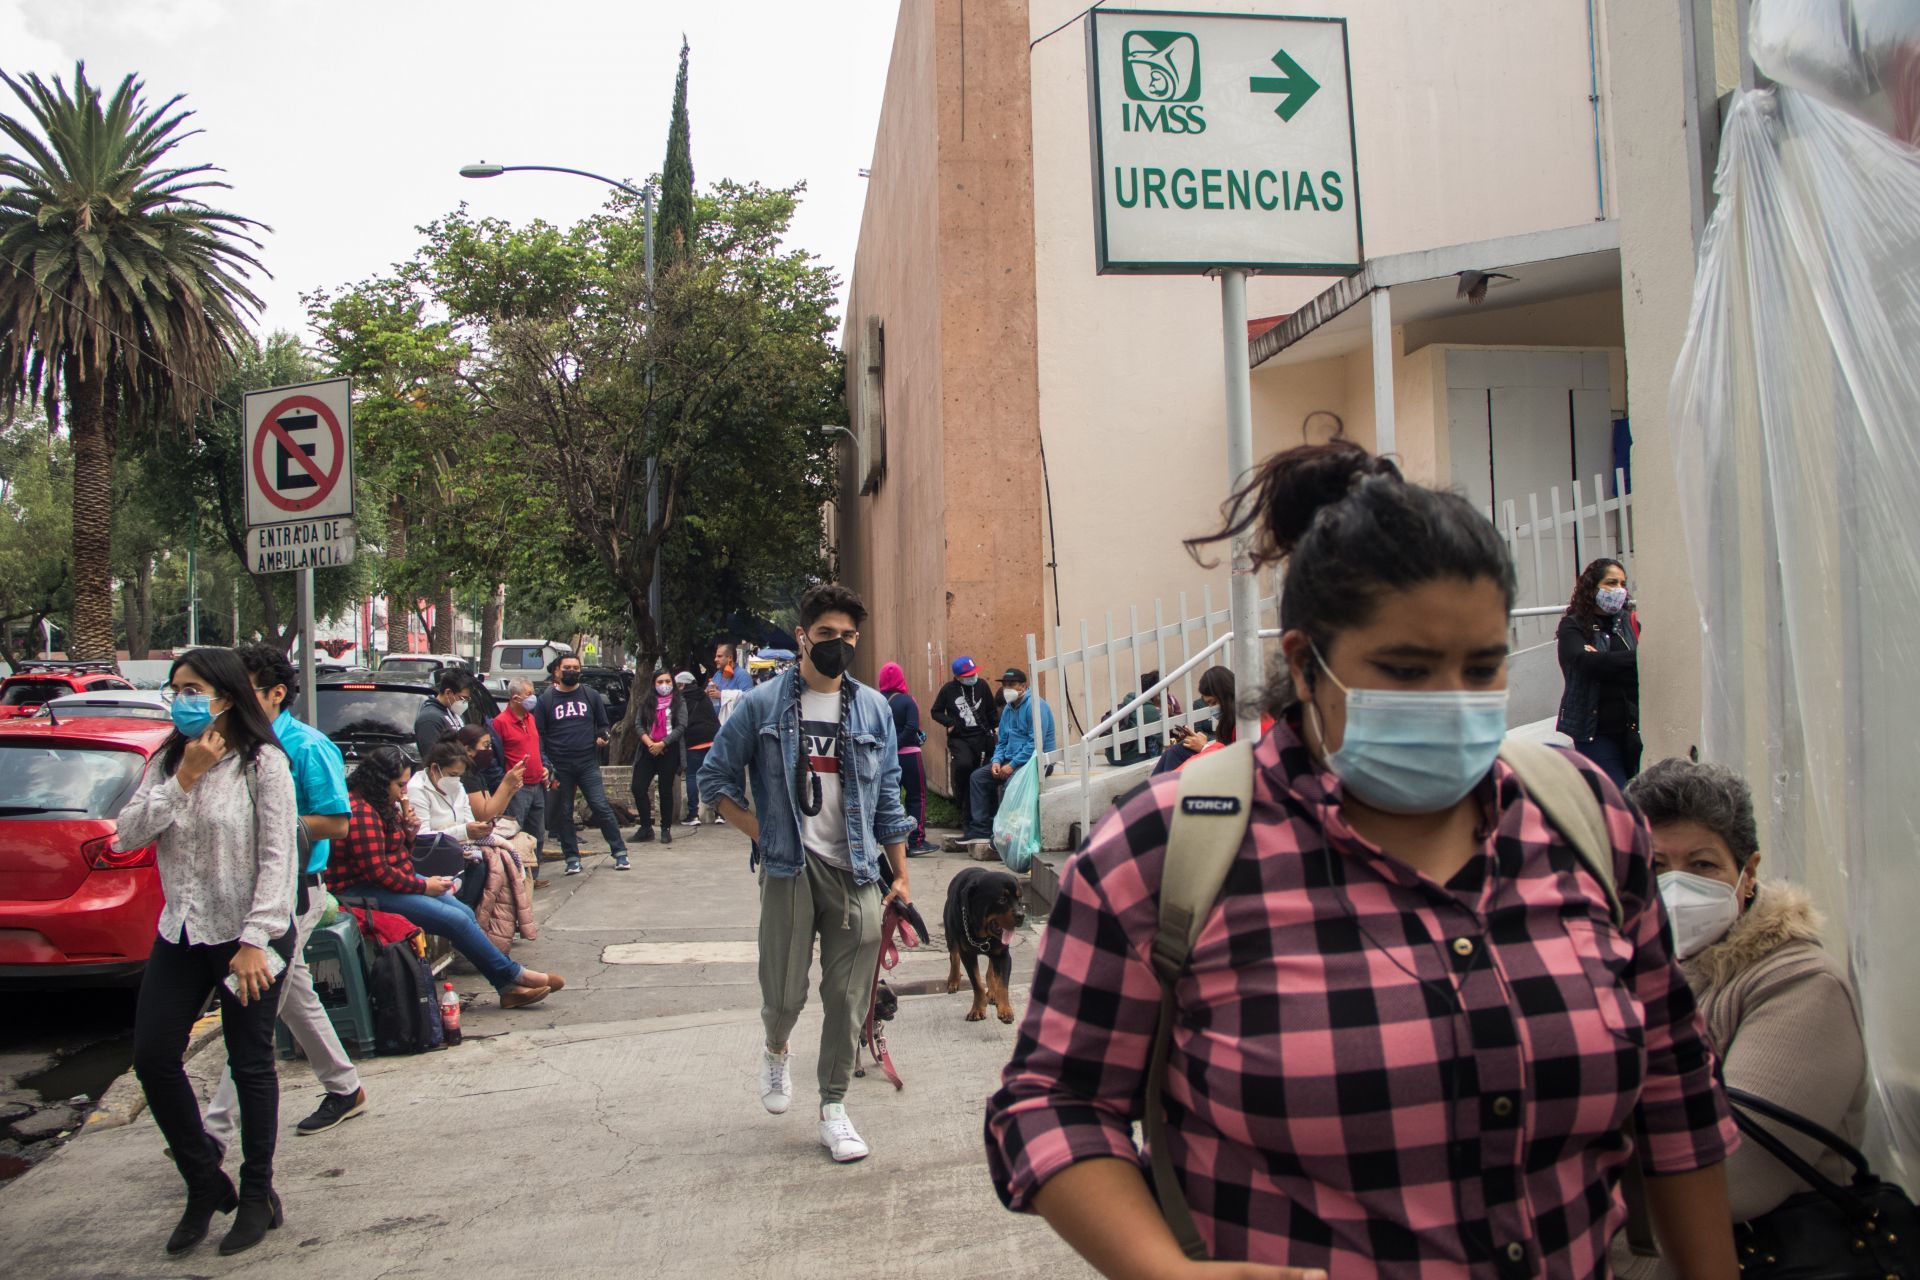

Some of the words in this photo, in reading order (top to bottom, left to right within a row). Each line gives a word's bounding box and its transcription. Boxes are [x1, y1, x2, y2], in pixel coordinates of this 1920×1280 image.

[1122, 103, 1207, 134] IMSS
[1115, 166, 1344, 212] URGENCIAS
[276, 414, 318, 490] E
[259, 523, 319, 548] ENTRADA
[324, 521, 340, 541] DE
[258, 545, 343, 572] AMBULANCIA
[555, 701, 588, 720] GAP
[1186, 800, 1234, 810] TORCH
